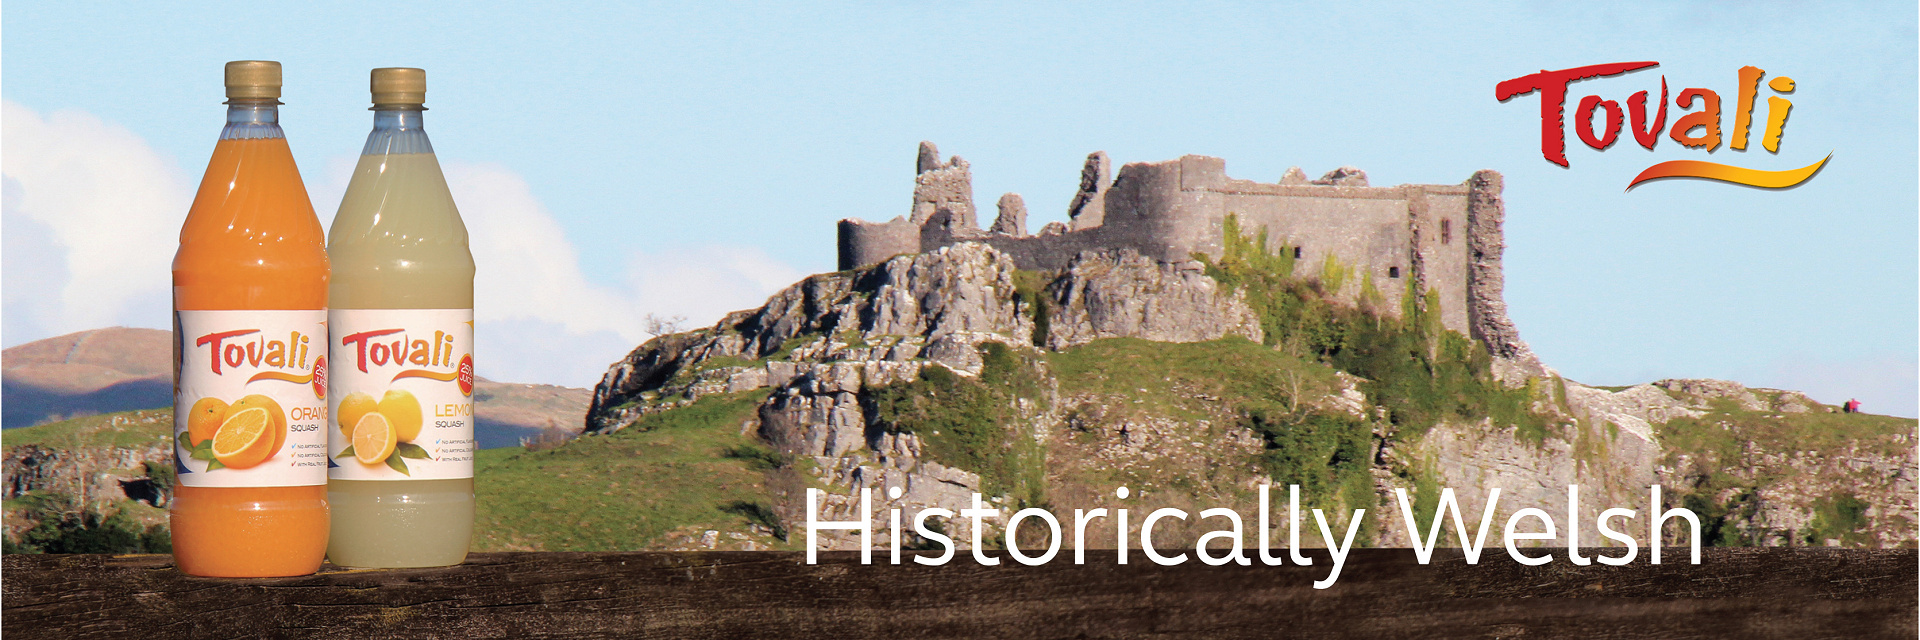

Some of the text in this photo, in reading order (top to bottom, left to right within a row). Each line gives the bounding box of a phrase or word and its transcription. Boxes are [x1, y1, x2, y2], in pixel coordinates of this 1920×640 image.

[196, 329, 309, 376] Tovali
[342, 328, 454, 374] Tovali
[290, 424, 319, 432] SQUASH
[435, 420, 465, 428] SQUASH
